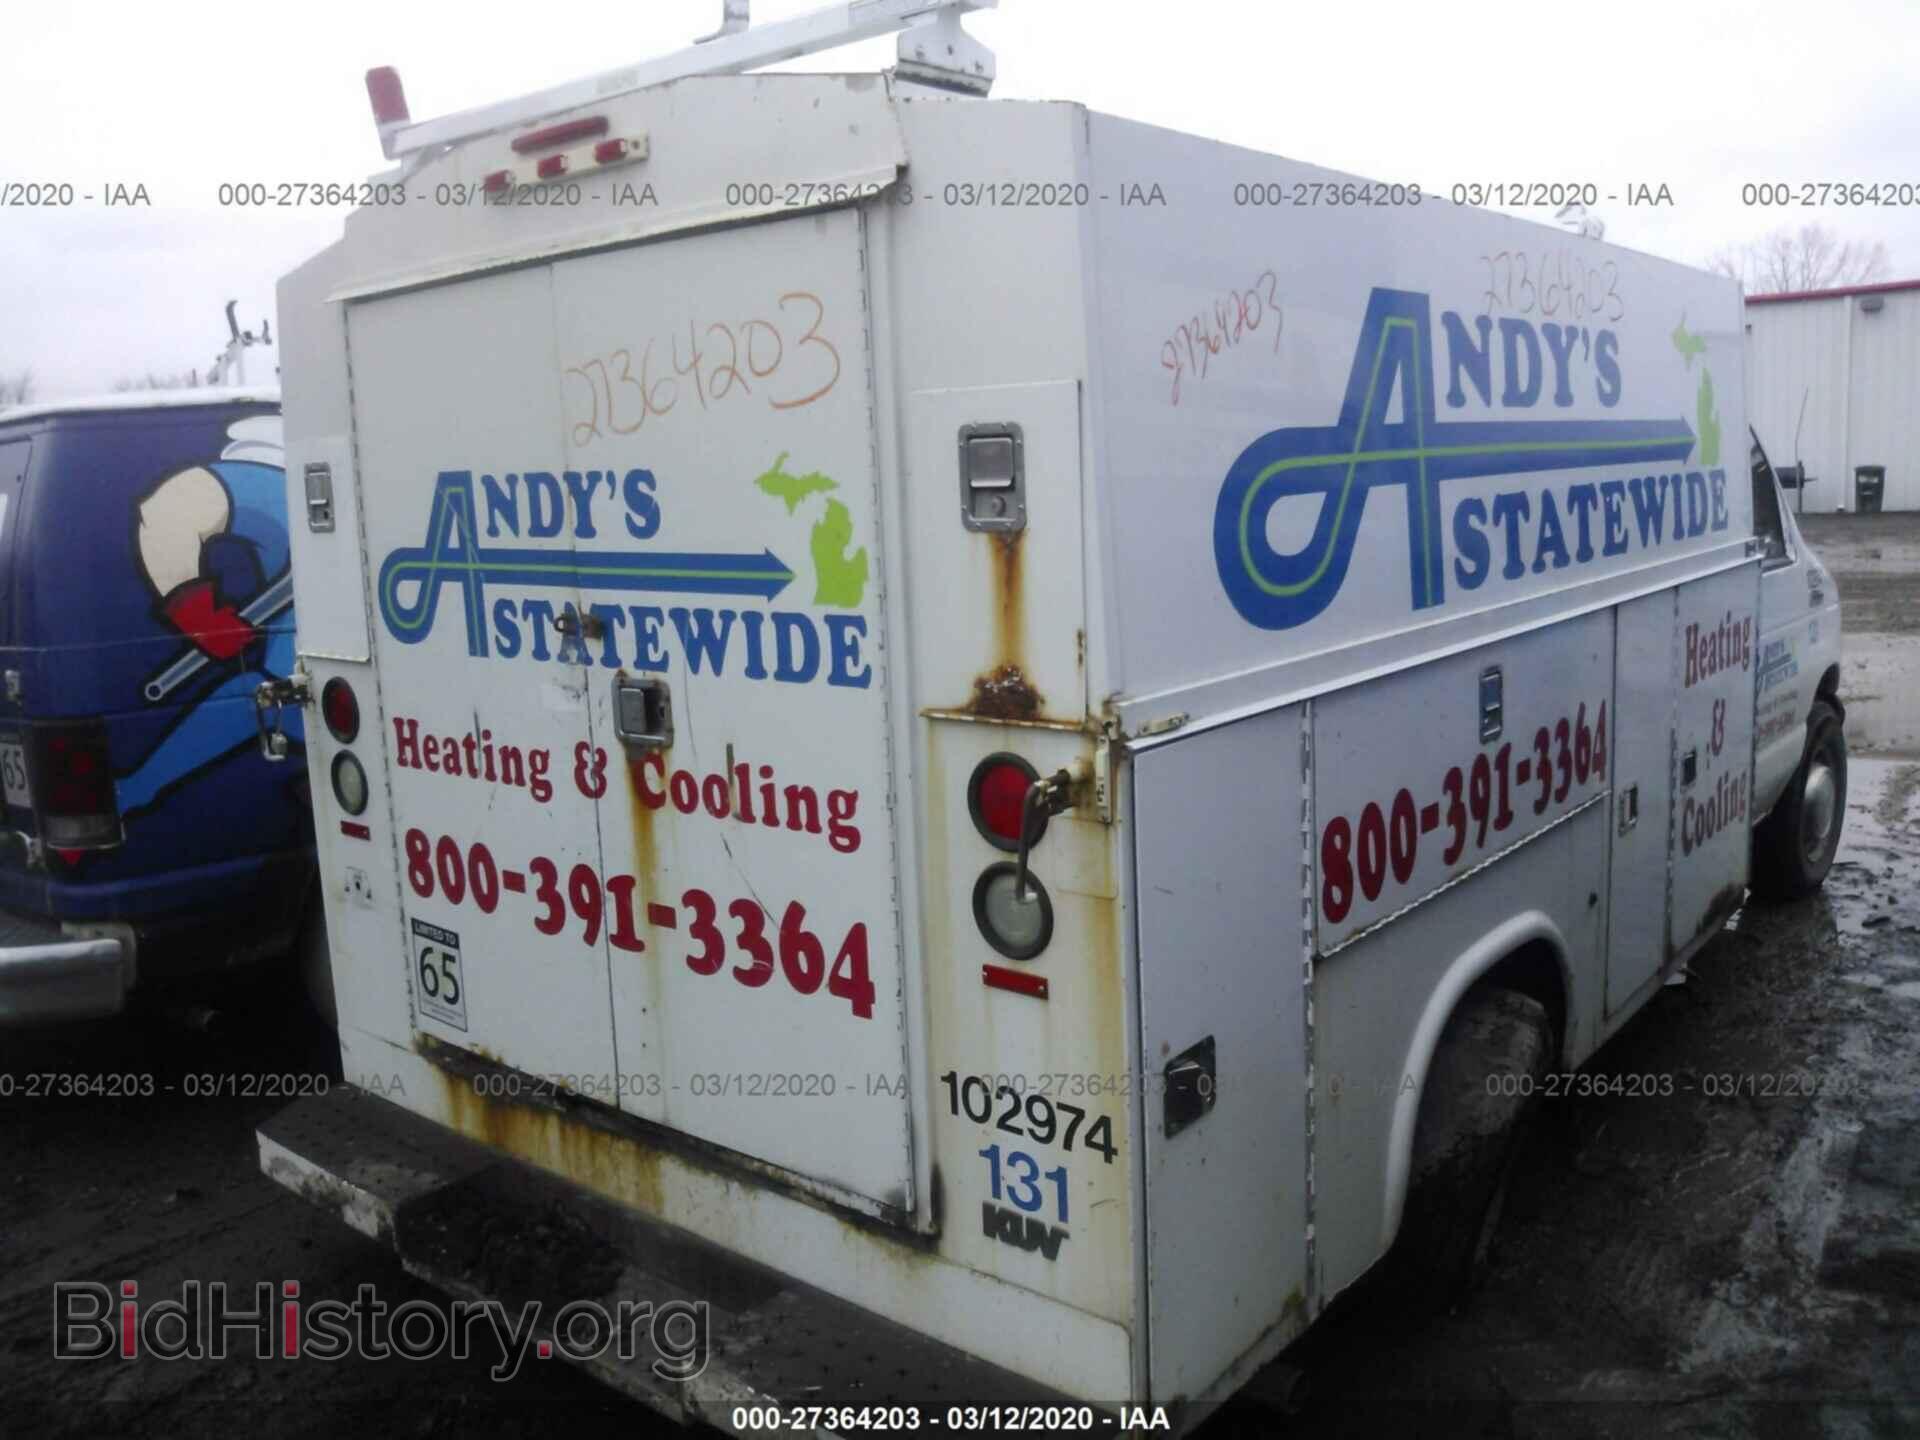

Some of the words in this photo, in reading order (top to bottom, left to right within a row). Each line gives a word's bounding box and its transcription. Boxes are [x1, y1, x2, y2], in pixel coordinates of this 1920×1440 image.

[1453, 466, 1729, 590] STATEWIDE
[492, 598, 872, 689] STATEWIDE
[1685, 610, 1752, 689] Heating
[1711, 699, 1726, 756] &
[393, 717, 553, 803] Heating
[574, 741, 608, 800] &
[636, 752, 862, 854] Cooling
[1321, 700, 1607, 924] 800-391-3364
[1681, 771, 1747, 857] Cooling
[405, 828, 876, 1020] 800-391-3364
[420, 946, 460, 1006] 65
[940, 1069, 1118, 1165] 102974
[978, 1143, 1070, 1223] 131
